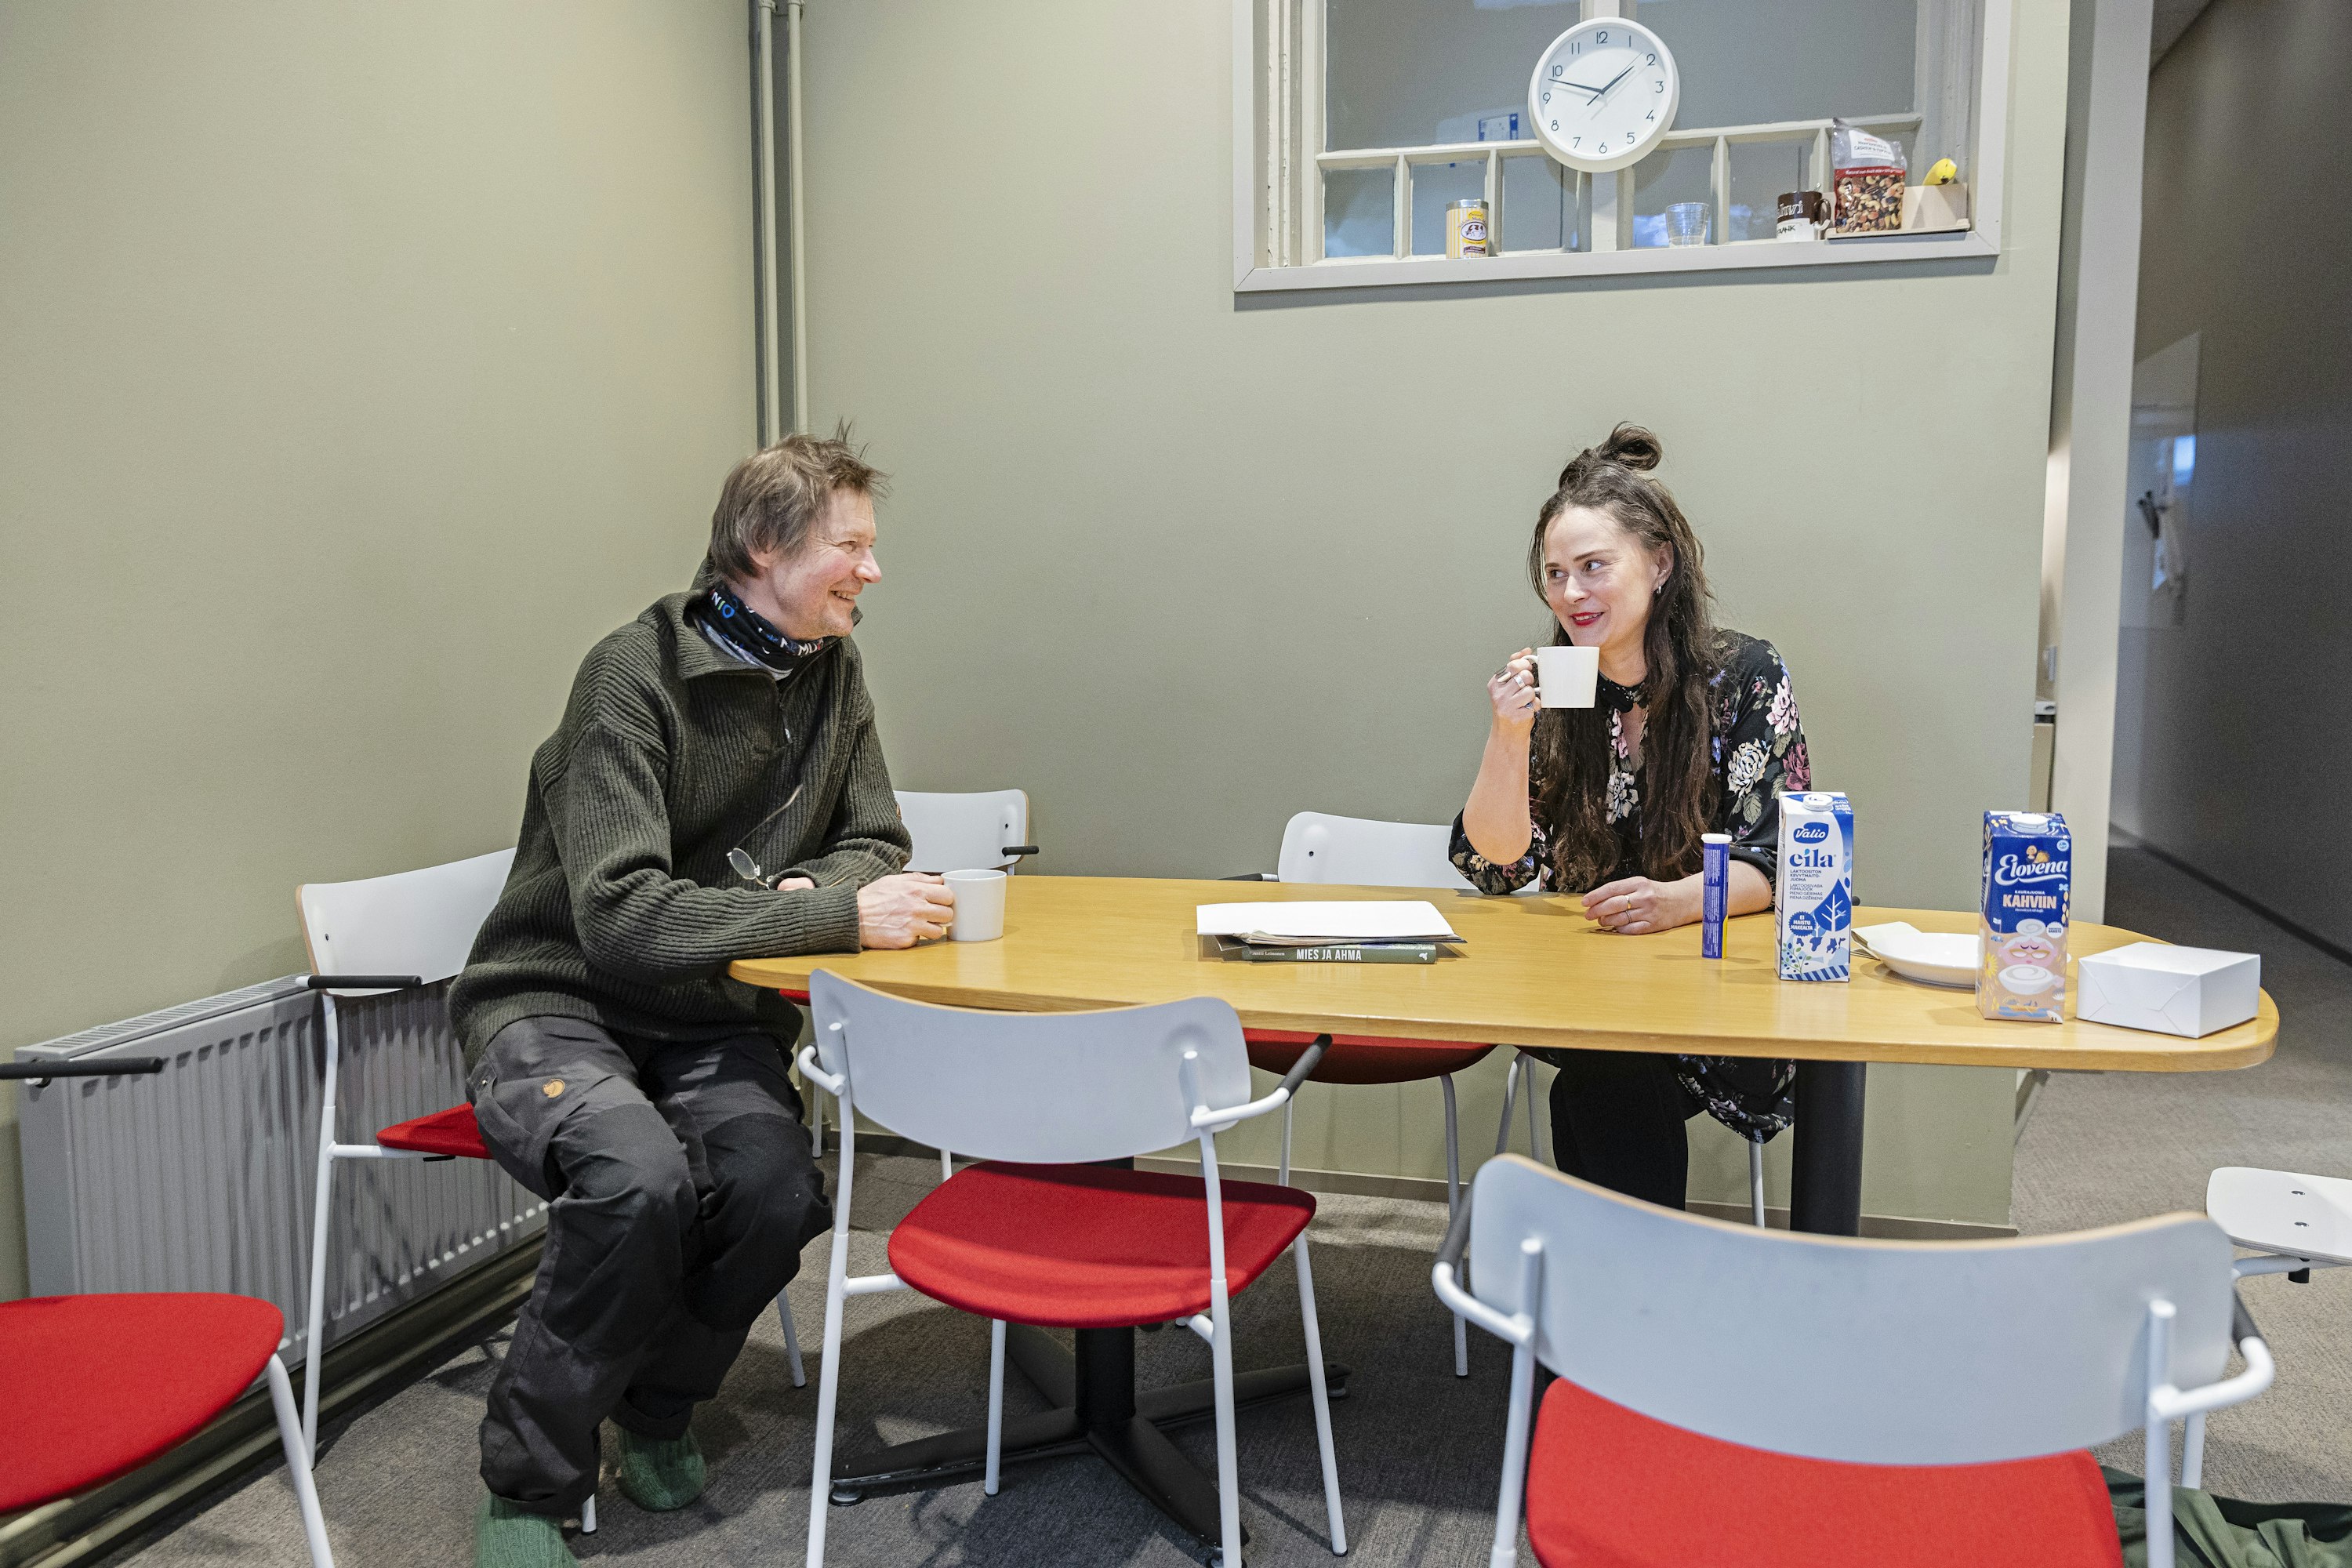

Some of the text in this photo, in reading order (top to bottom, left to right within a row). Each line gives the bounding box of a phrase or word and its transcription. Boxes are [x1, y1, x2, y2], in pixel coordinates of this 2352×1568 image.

[1596, 31, 1608, 44] 12
[1628, 35, 1632, 48] 1
[1571, 42, 1580, 55] 11
[1646, 53, 1656, 66] 2
[1552, 65, 1563, 78] 10
[1655, 81, 1664, 93] 3
[1542, 93, 1551, 104] 9
[1646, 109, 1654, 122] 4
[1551, 119, 1559, 132] 8
[1573, 136, 1581, 149] 7
[1627, 132, 1635, 144] 5
[1599, 142, 1607, 154] 6
[1777, 200, 1803, 217] hvi
[1795, 829, 1826, 838] Valio
[1789, 848, 1834, 868] eila
[1994, 854, 2068, 886] Elovena
[2002, 894, 2057, 909] KAHVIIN
[1296, 949, 1362, 961] MIES JA AHMA
